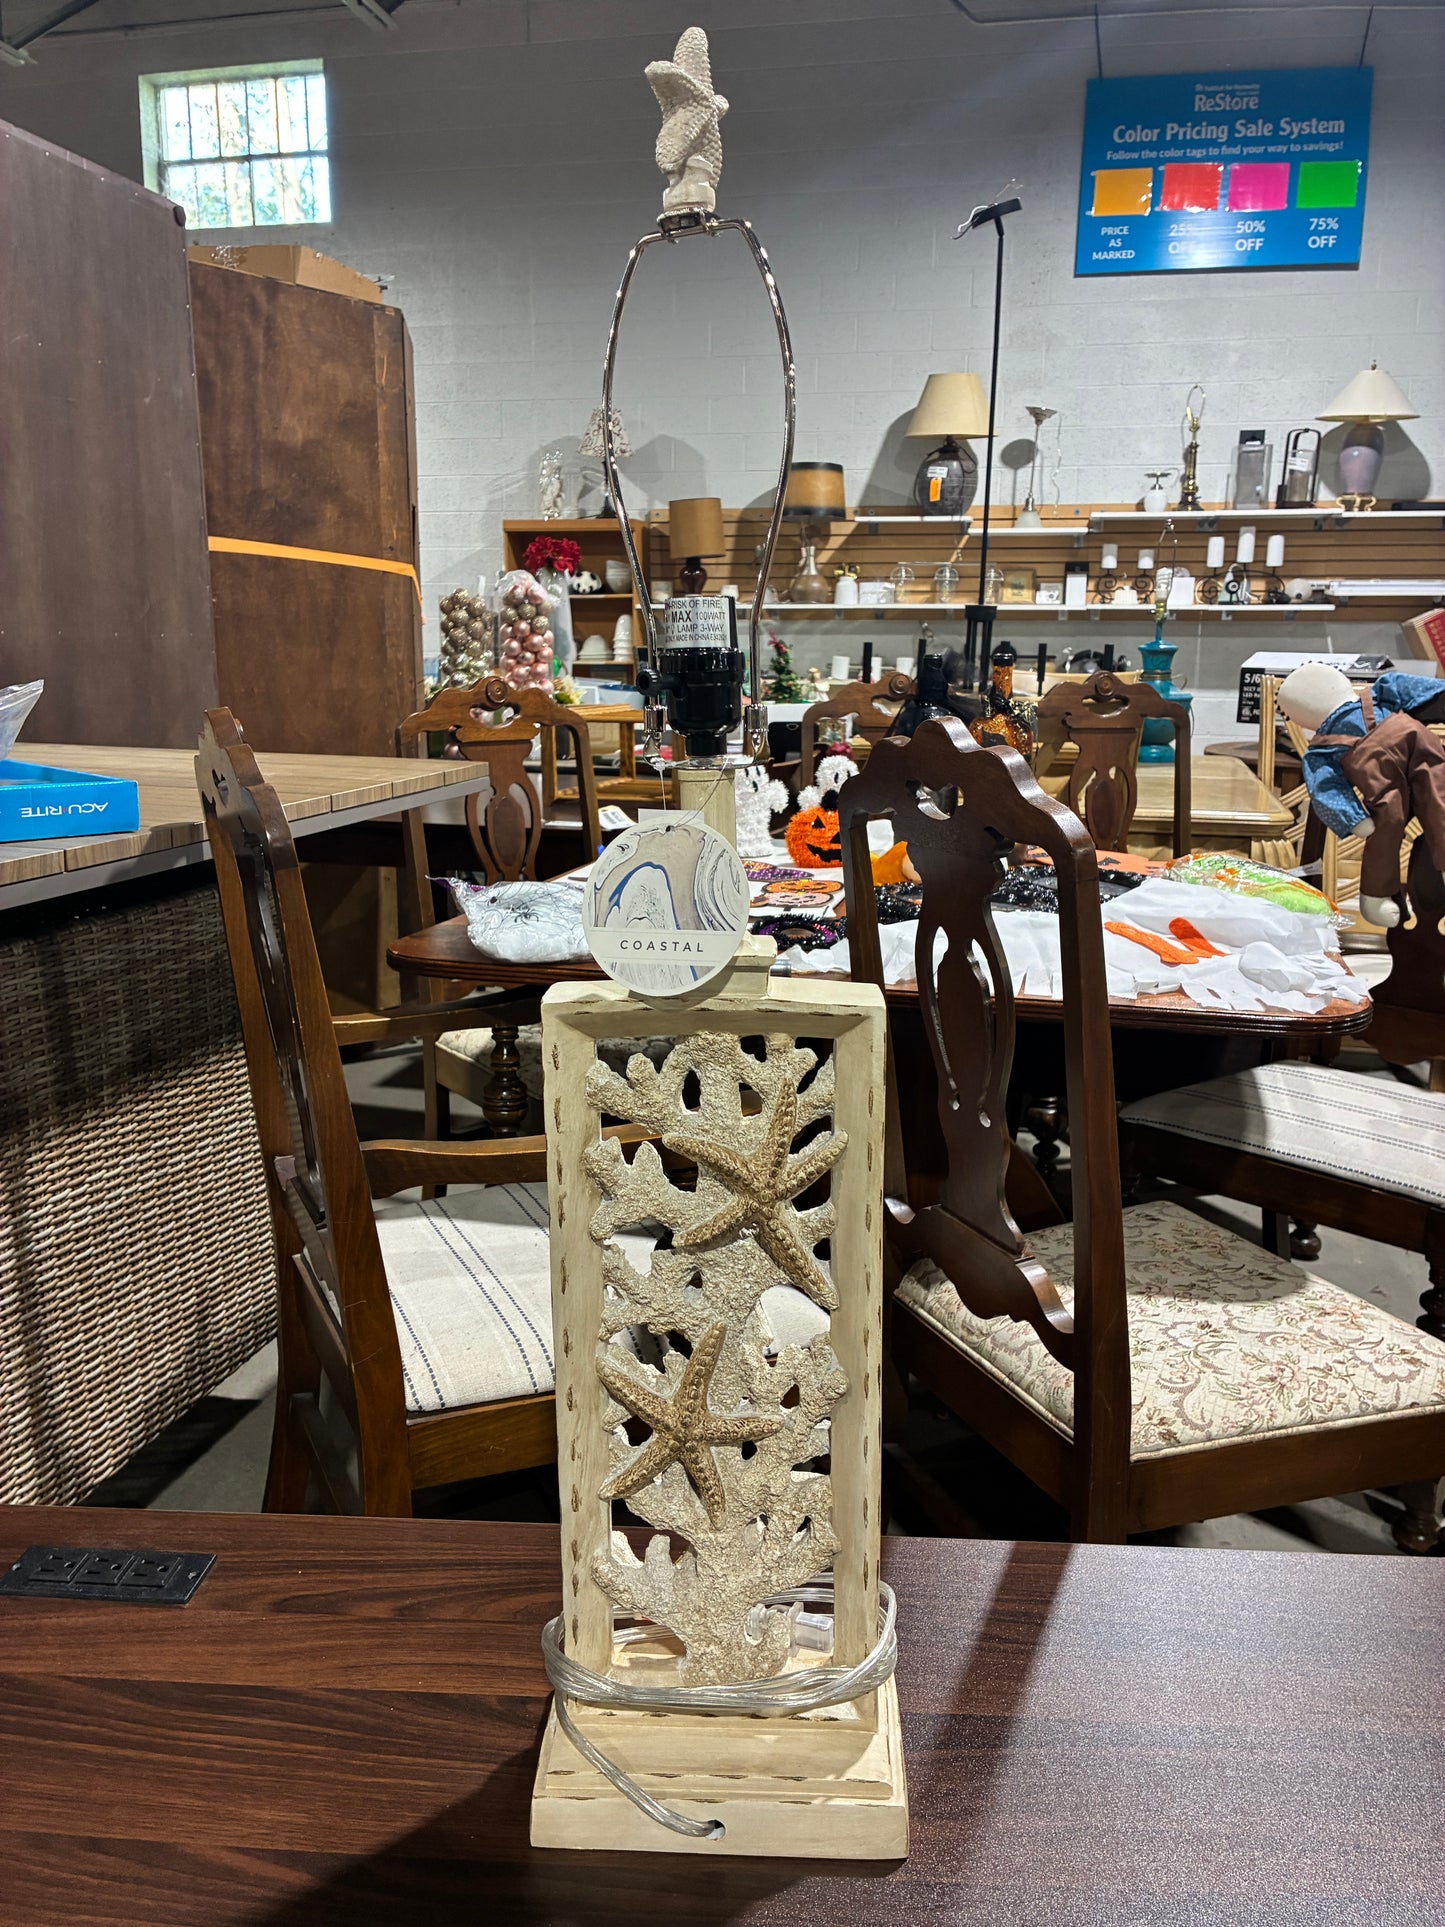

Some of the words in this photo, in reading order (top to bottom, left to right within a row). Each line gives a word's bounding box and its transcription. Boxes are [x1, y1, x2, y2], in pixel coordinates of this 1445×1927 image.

[1194, 93, 1259, 112] ReStore
[1113, 124, 1160, 143] Color
[1166, 121, 1229, 142] Pricing
[1234, 119, 1273, 138] Sale
[1279, 117, 1345, 139] System
[1106, 149, 1139, 160] Follow
[1141, 149, 1157, 159] the
[1159, 147, 1184, 157] color
[1186, 147, 1207, 158] tags
[1208, 146, 1219, 155] to
[1221, 144, 1241, 155] find
[1242, 145, 1265, 156] your
[1267, 144, 1289, 154] way
[1290, 142, 1301, 152] to
[1302, 140, 1344, 152] savings!
[1235, 220, 1266, 234] 50%
[1308, 217, 1339, 231] 75%
[1101, 226, 1129, 236] PRICE
[1108, 239, 1122, 248] AS
[1234, 238, 1265, 252] OFF
[1307, 235, 1337, 249] OFF
[1092, 250, 1136, 261] MARKED
[689, 599, 700, 609] OF
[671, 610, 692, 623] MAX
[677, 623, 698, 633] LAMP
[700, 623, 724, 633] 3-WAY
[620, 940, 703, 952] COASTAL
